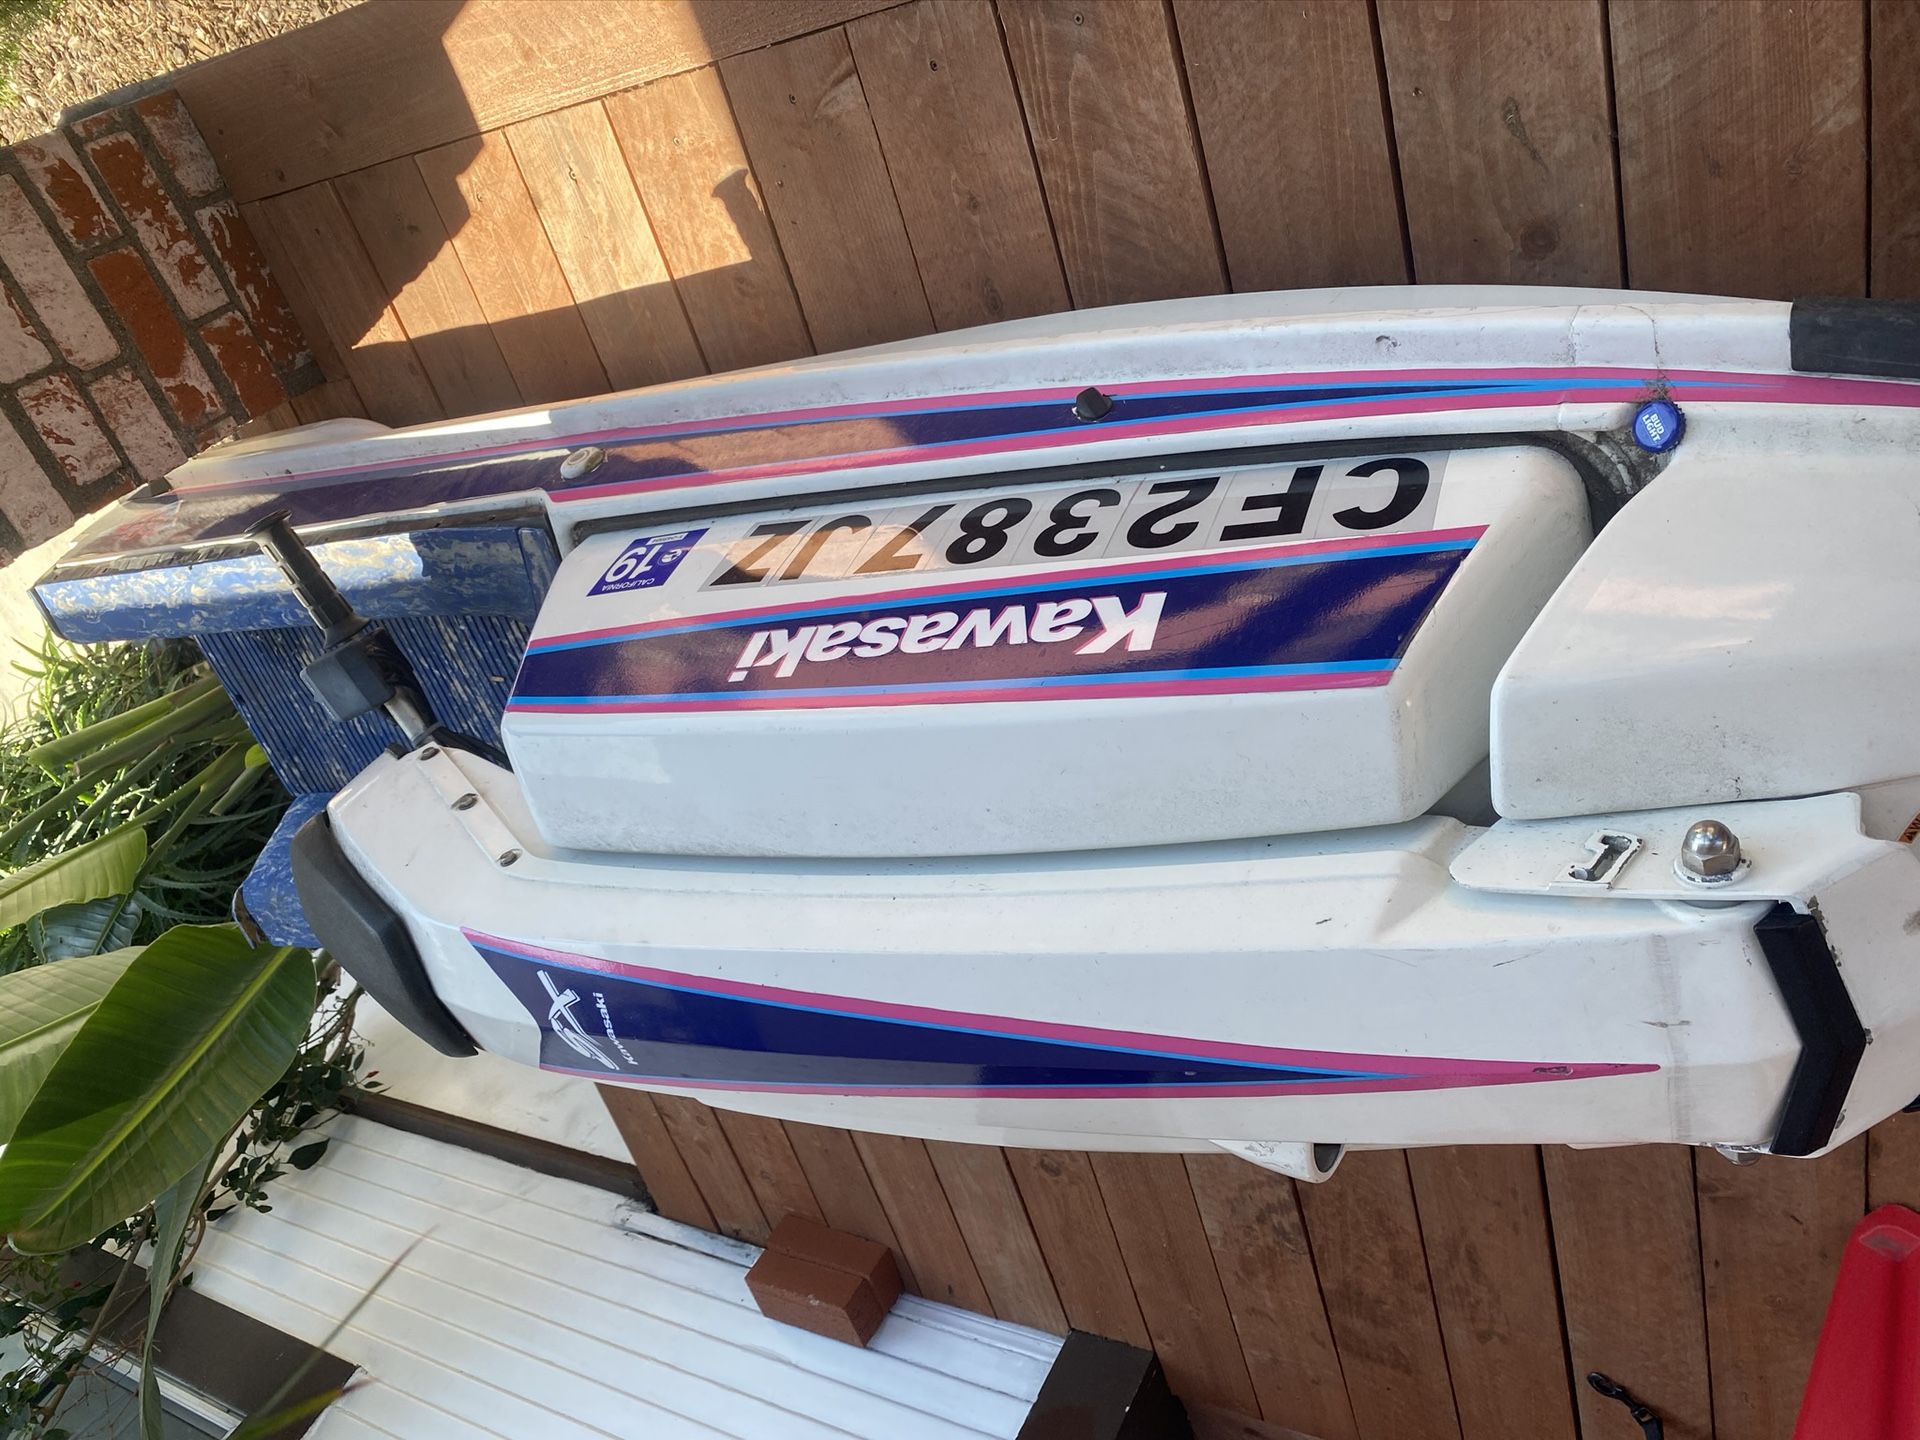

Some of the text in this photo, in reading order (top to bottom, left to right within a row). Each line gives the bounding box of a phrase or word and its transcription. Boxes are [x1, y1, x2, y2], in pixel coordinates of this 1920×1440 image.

[1641, 414, 1661, 442] LIGHT
[1650, 413, 1665, 435] BUD
[605, 544, 663, 583] 19
[601, 577, 656, 592] CALIFORNIA
[728, 592, 1167, 683] Kawasaki
[592, 991, 639, 1066] Kawasaki
